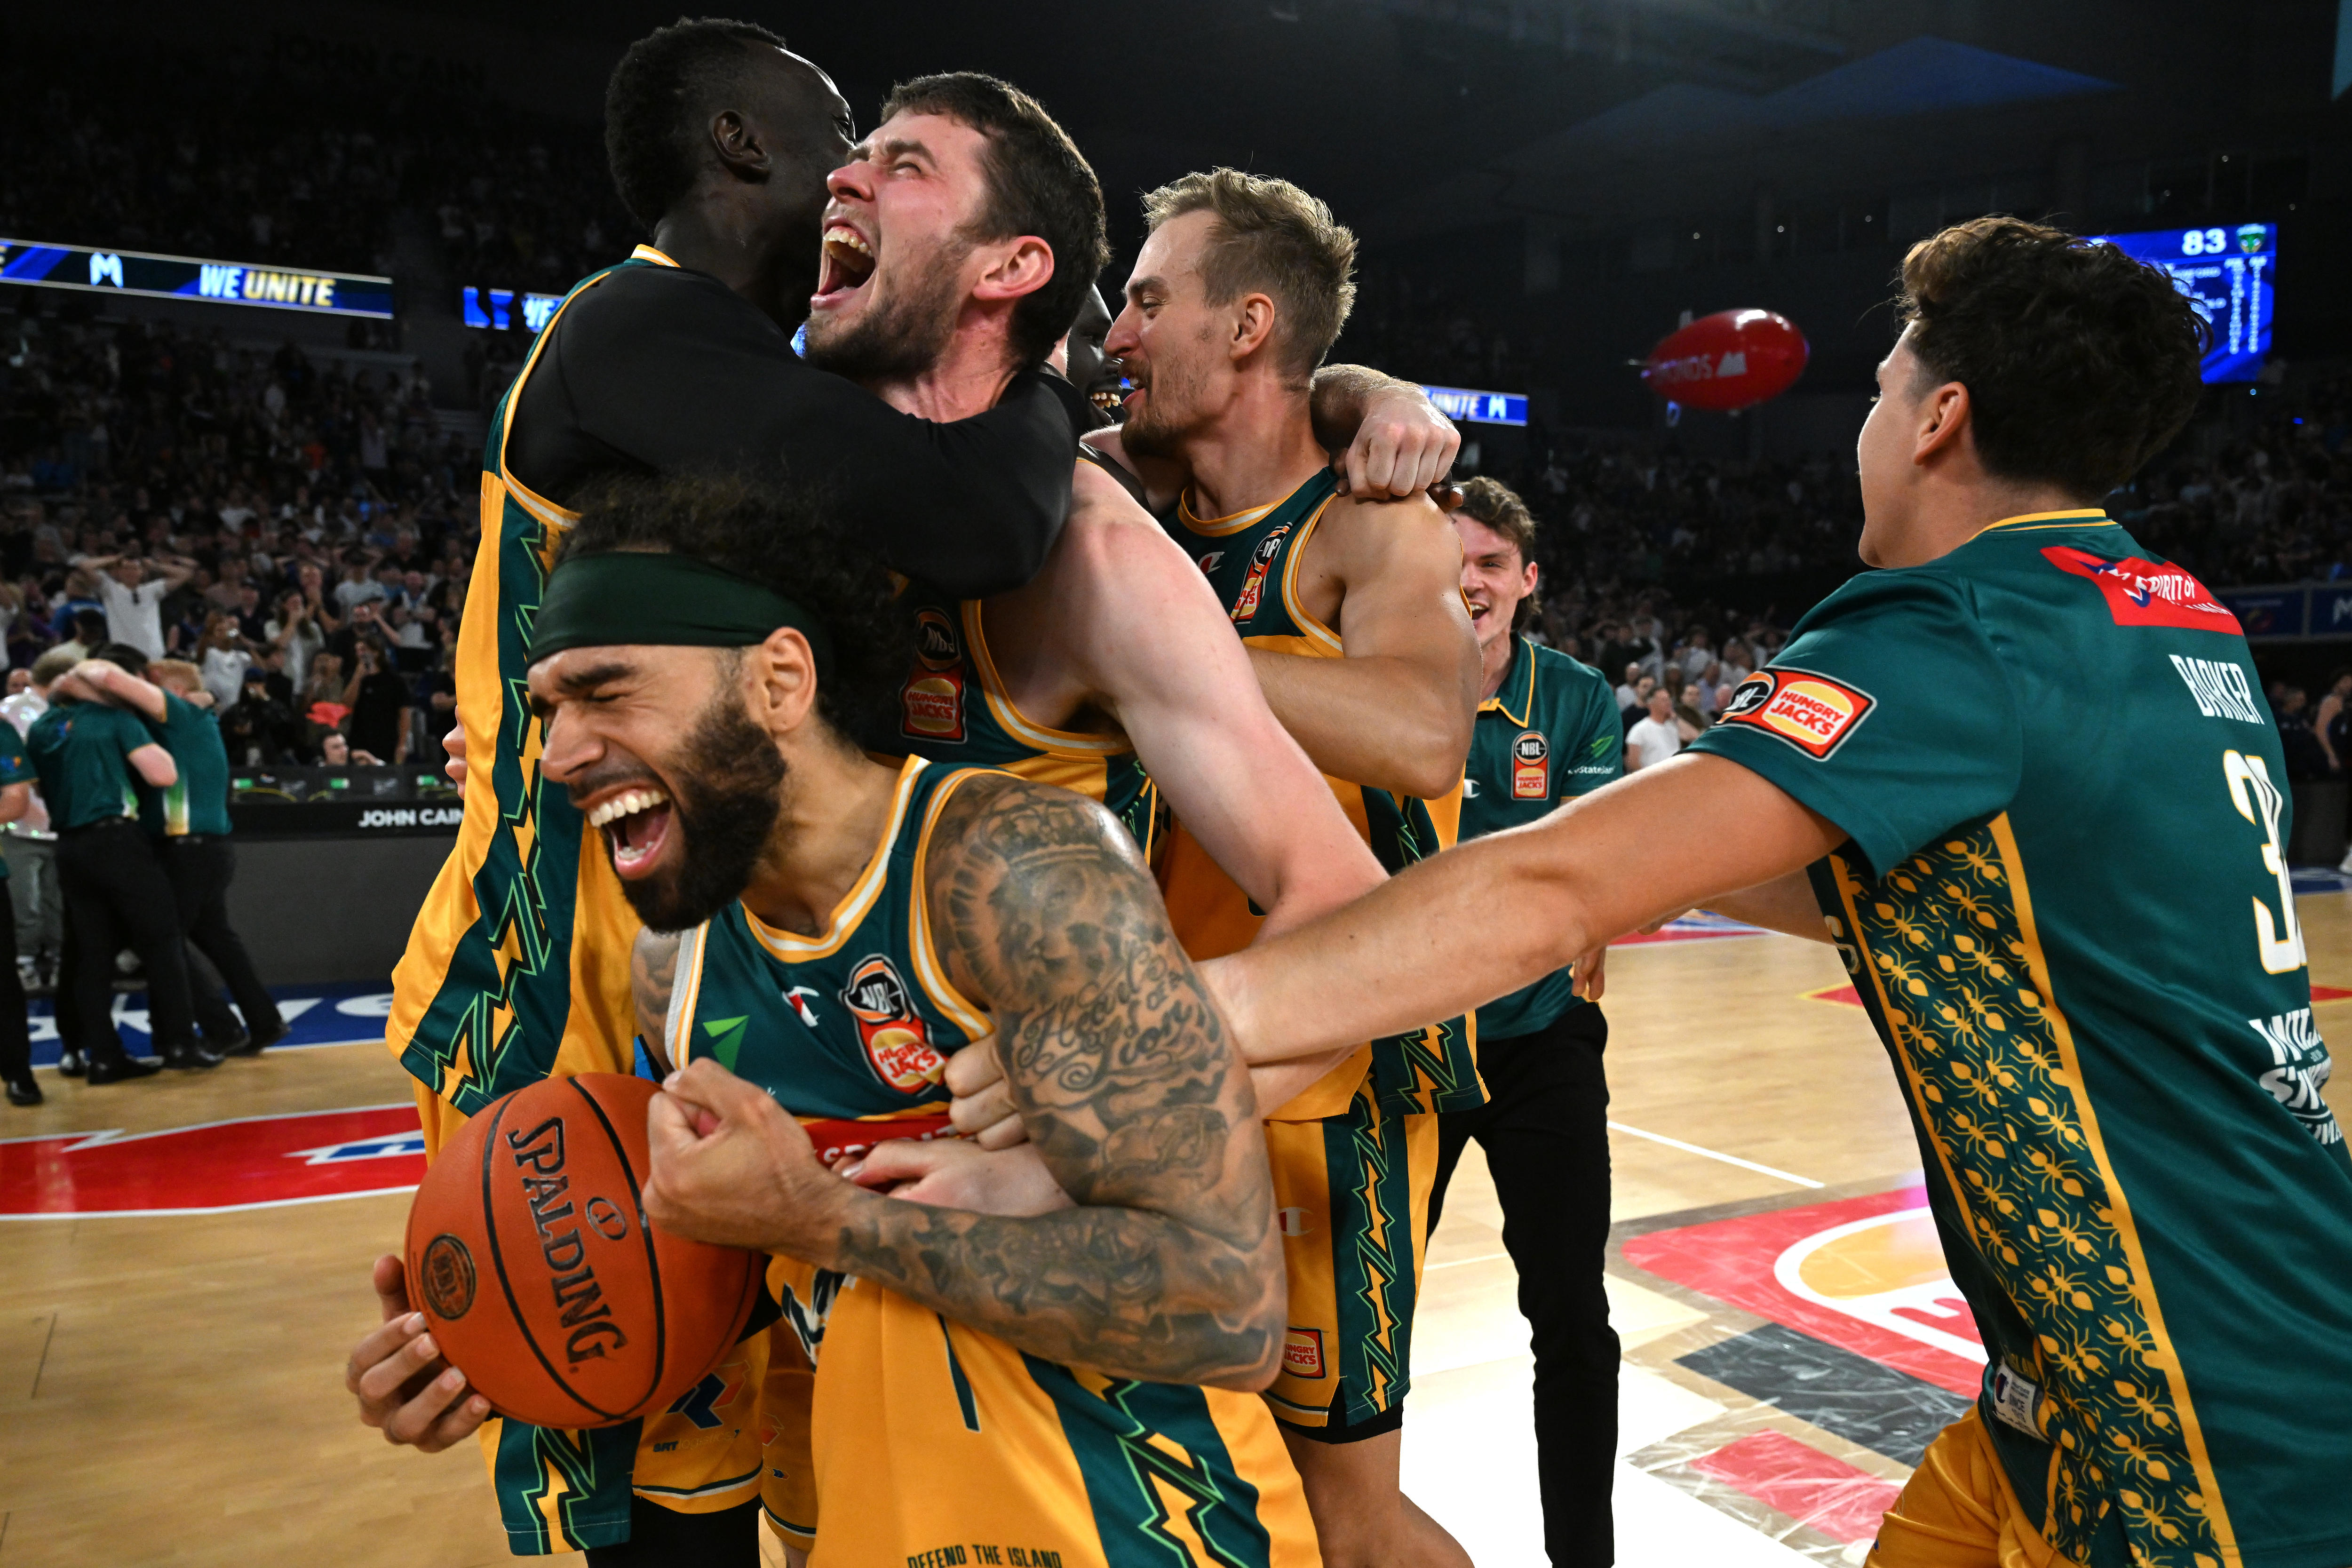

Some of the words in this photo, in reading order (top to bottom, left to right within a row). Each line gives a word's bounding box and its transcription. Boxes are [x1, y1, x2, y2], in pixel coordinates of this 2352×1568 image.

[2182, 228, 2226, 255] 83
[907, 692, 954, 705] HUNGRY
[2168, 653, 2265, 725] BARKER
[1780, 691, 1844, 723] HUNGRY
[1521, 742, 1541, 756] NBL
[358, 809, 417, 828] JOHN
[507, 1116, 628, 1364] SPALDING
[907, 1544, 967, 1568] DEFEND
[972, 1544, 1003, 1565] THE
[1007, 1546, 1065, 1568] ISLAND
